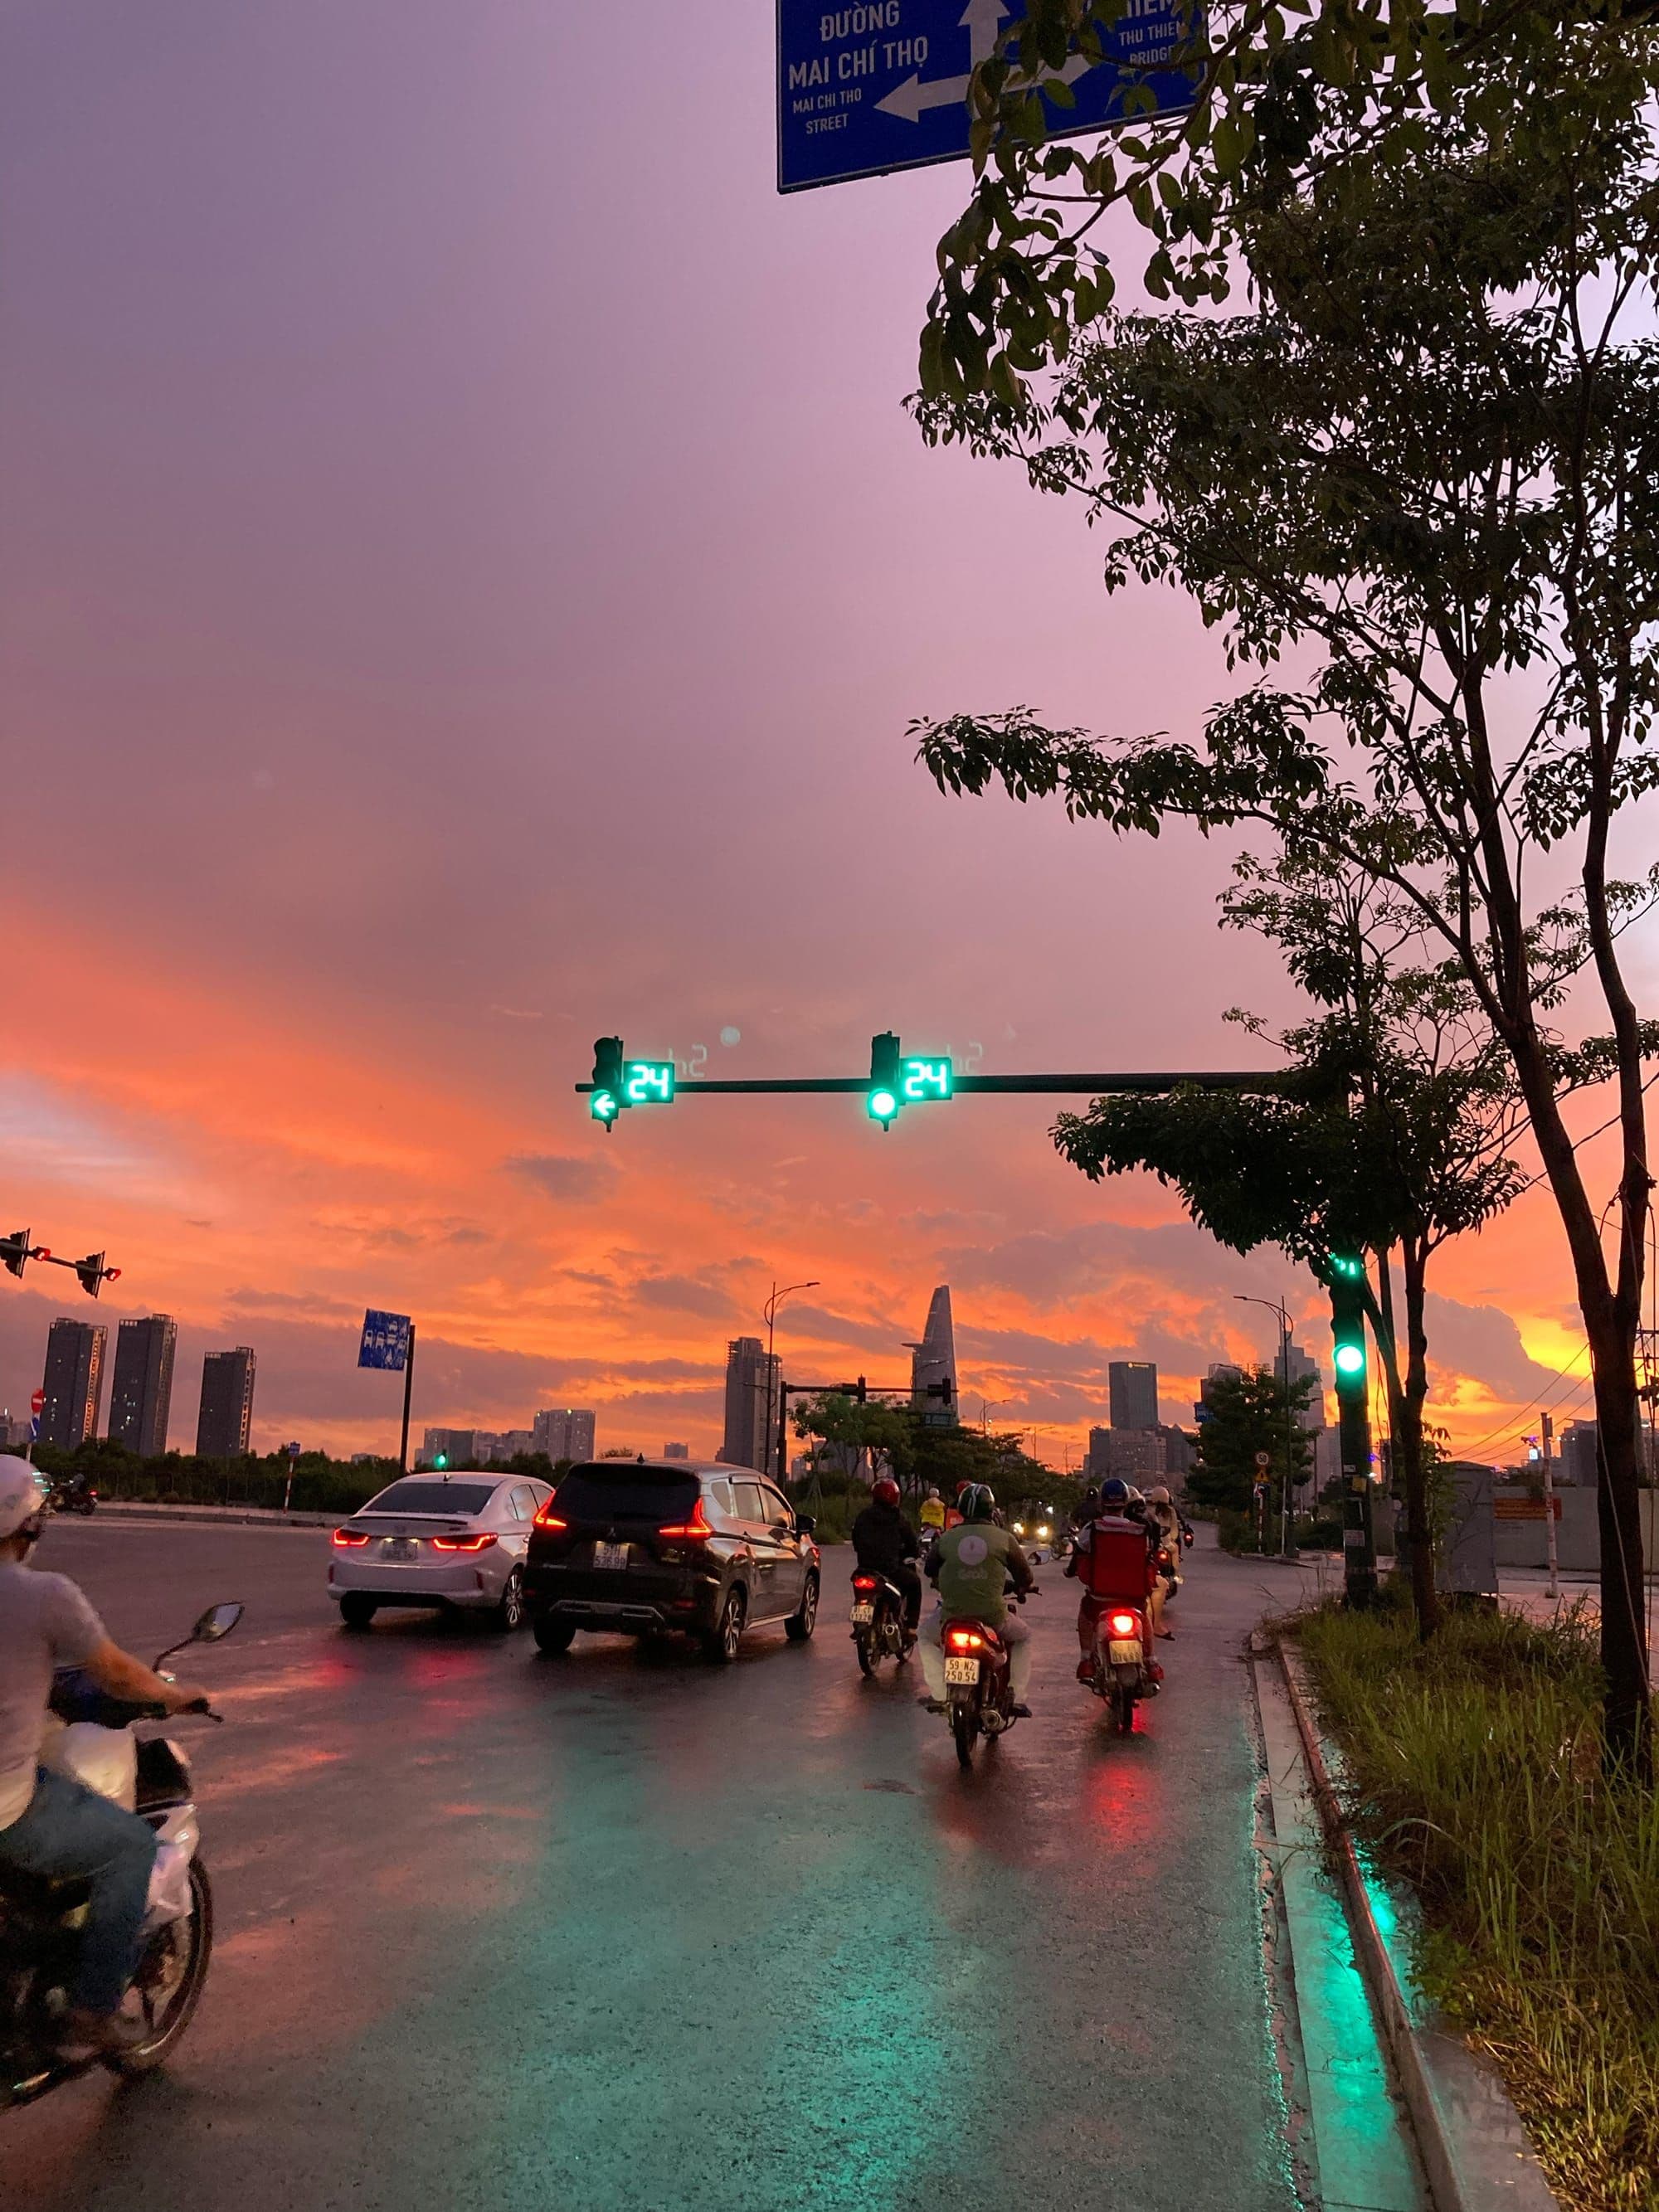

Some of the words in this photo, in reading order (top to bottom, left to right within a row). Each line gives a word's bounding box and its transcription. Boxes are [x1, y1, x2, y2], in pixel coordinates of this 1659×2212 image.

[819, 0, 900, 41] ĐƯỜNG
[1118, 27, 1144, 46] THU
[789, 56, 830, 90] MAI
[838, 39, 878, 80] CHÍ
[883, 35, 928, 70] THỌ
[792, 97, 814, 114] MAI
[817, 92, 836, 109] CHI
[840, 87, 863, 105] THO
[805, 113, 850, 134] STREET
[628, 1063, 670, 1100] 24
[904, 1061, 948, 1097] 24
